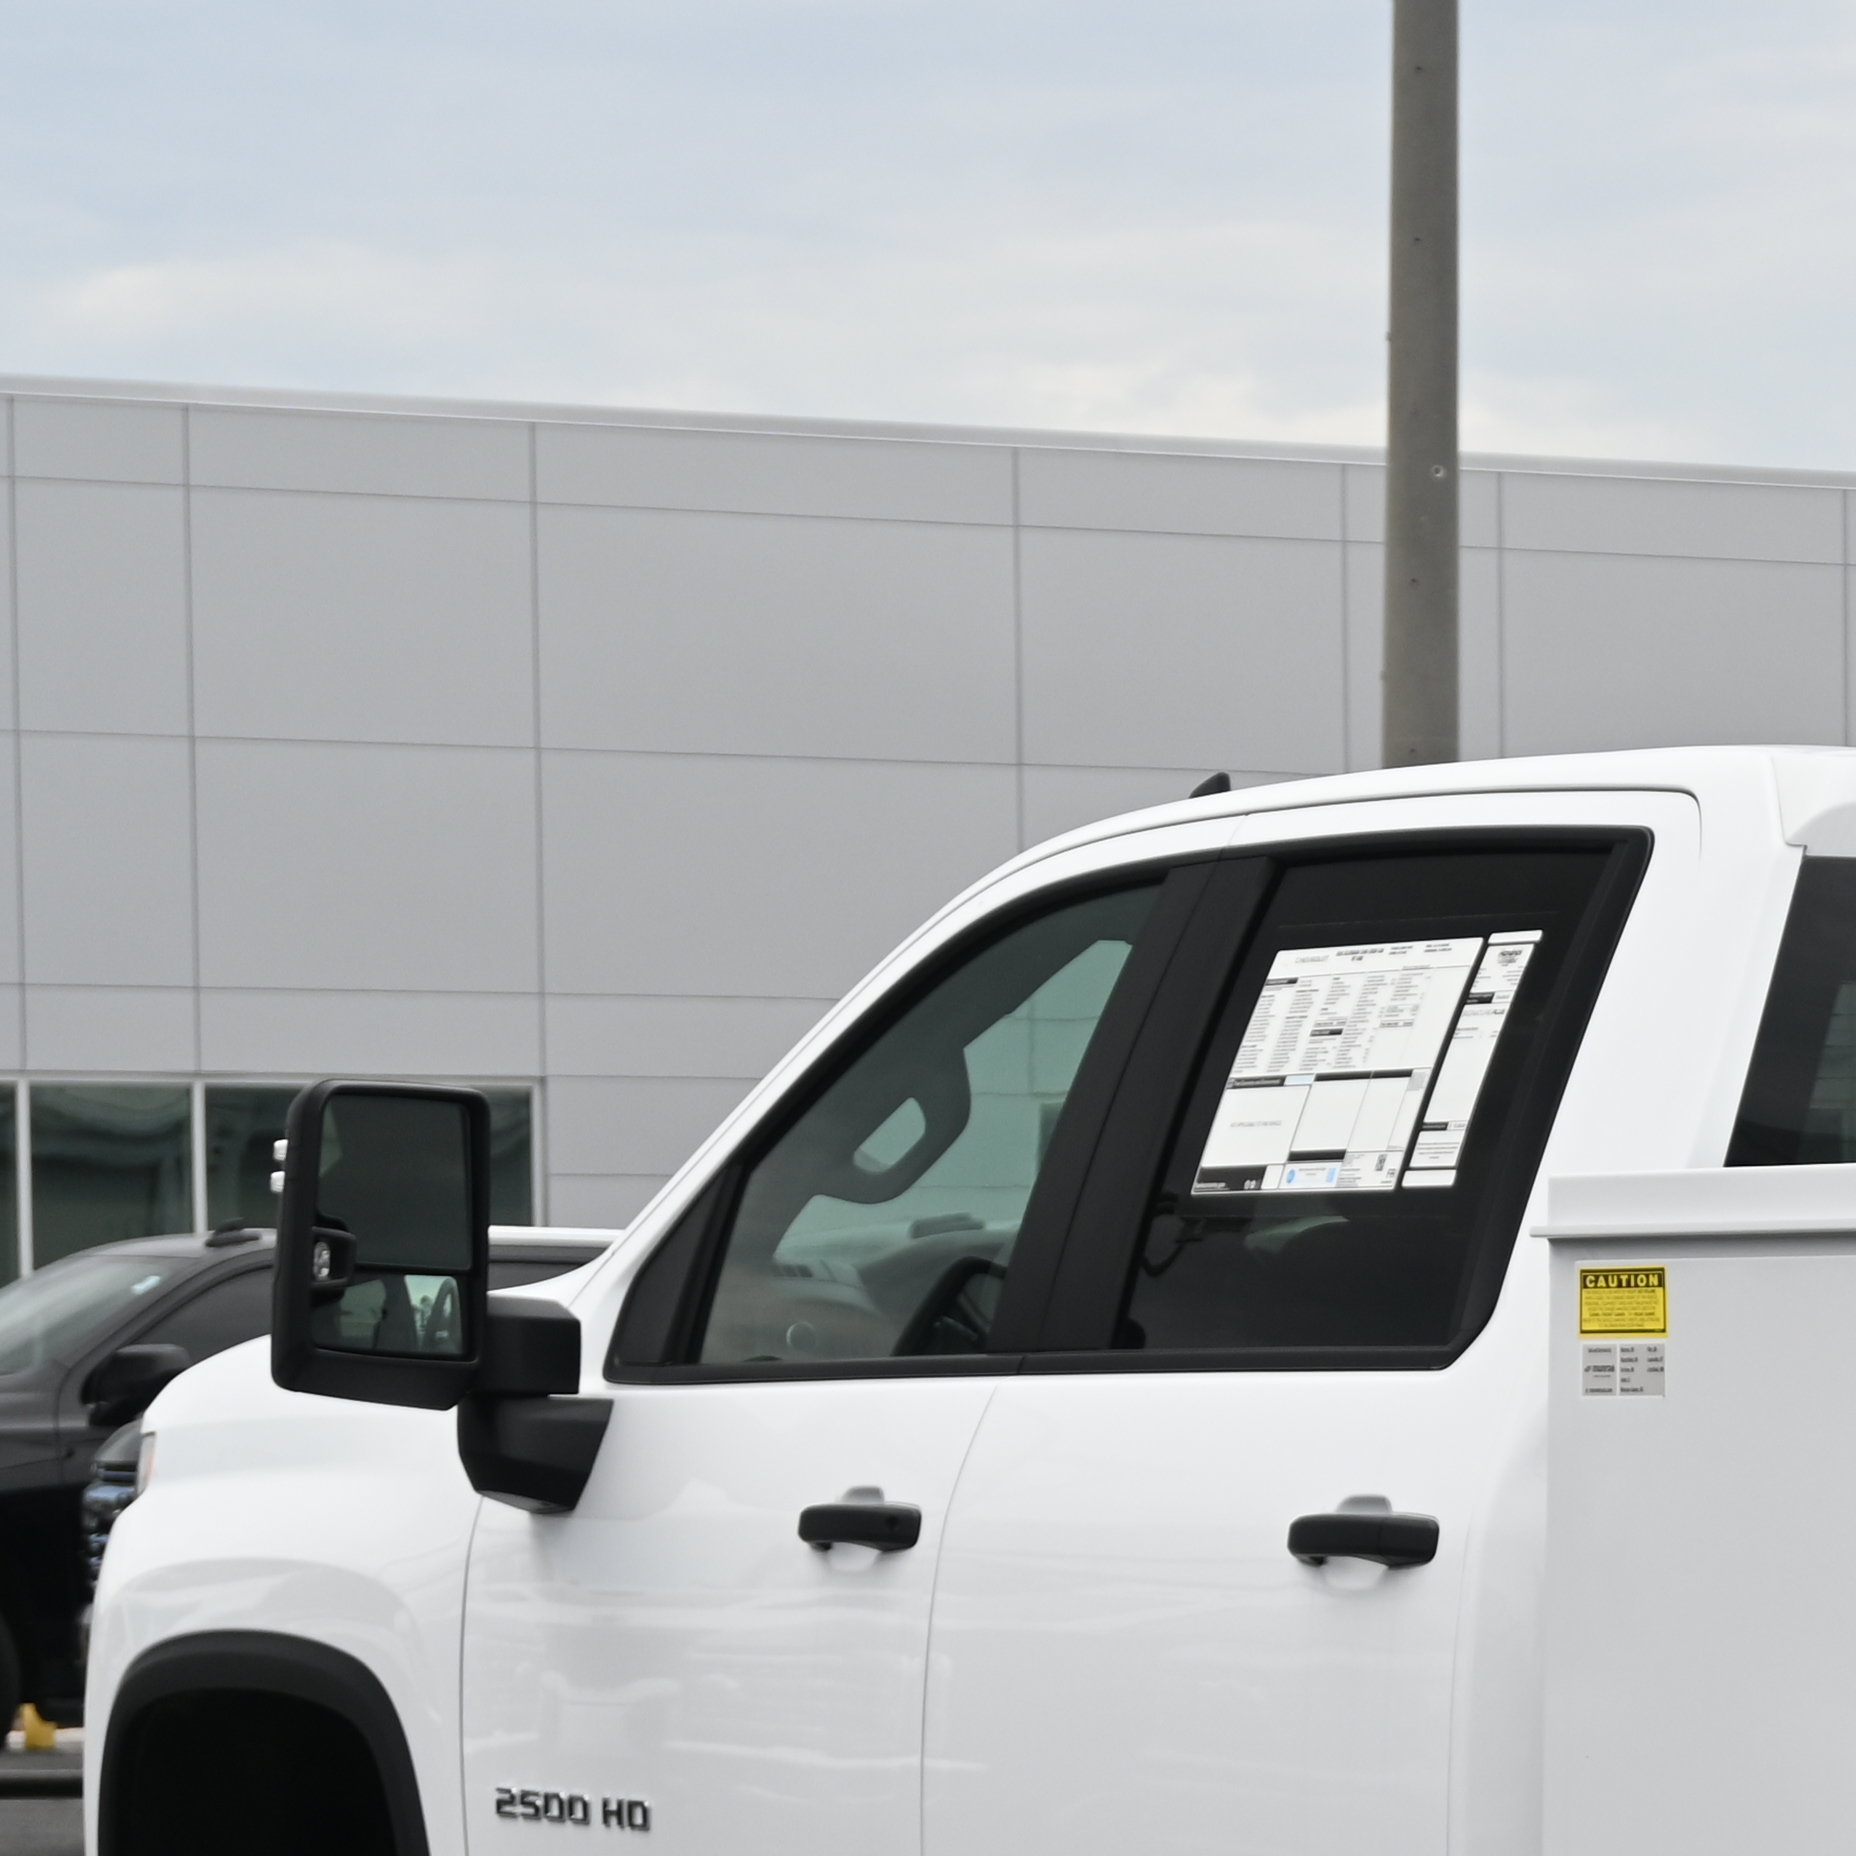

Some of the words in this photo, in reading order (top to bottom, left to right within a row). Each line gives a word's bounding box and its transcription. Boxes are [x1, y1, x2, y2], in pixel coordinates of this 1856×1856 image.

[1585, 1274, 1659, 1288] CAUTION
[495, 1787, 591, 1825] 2500
[602, 1796, 651, 1831] HD
